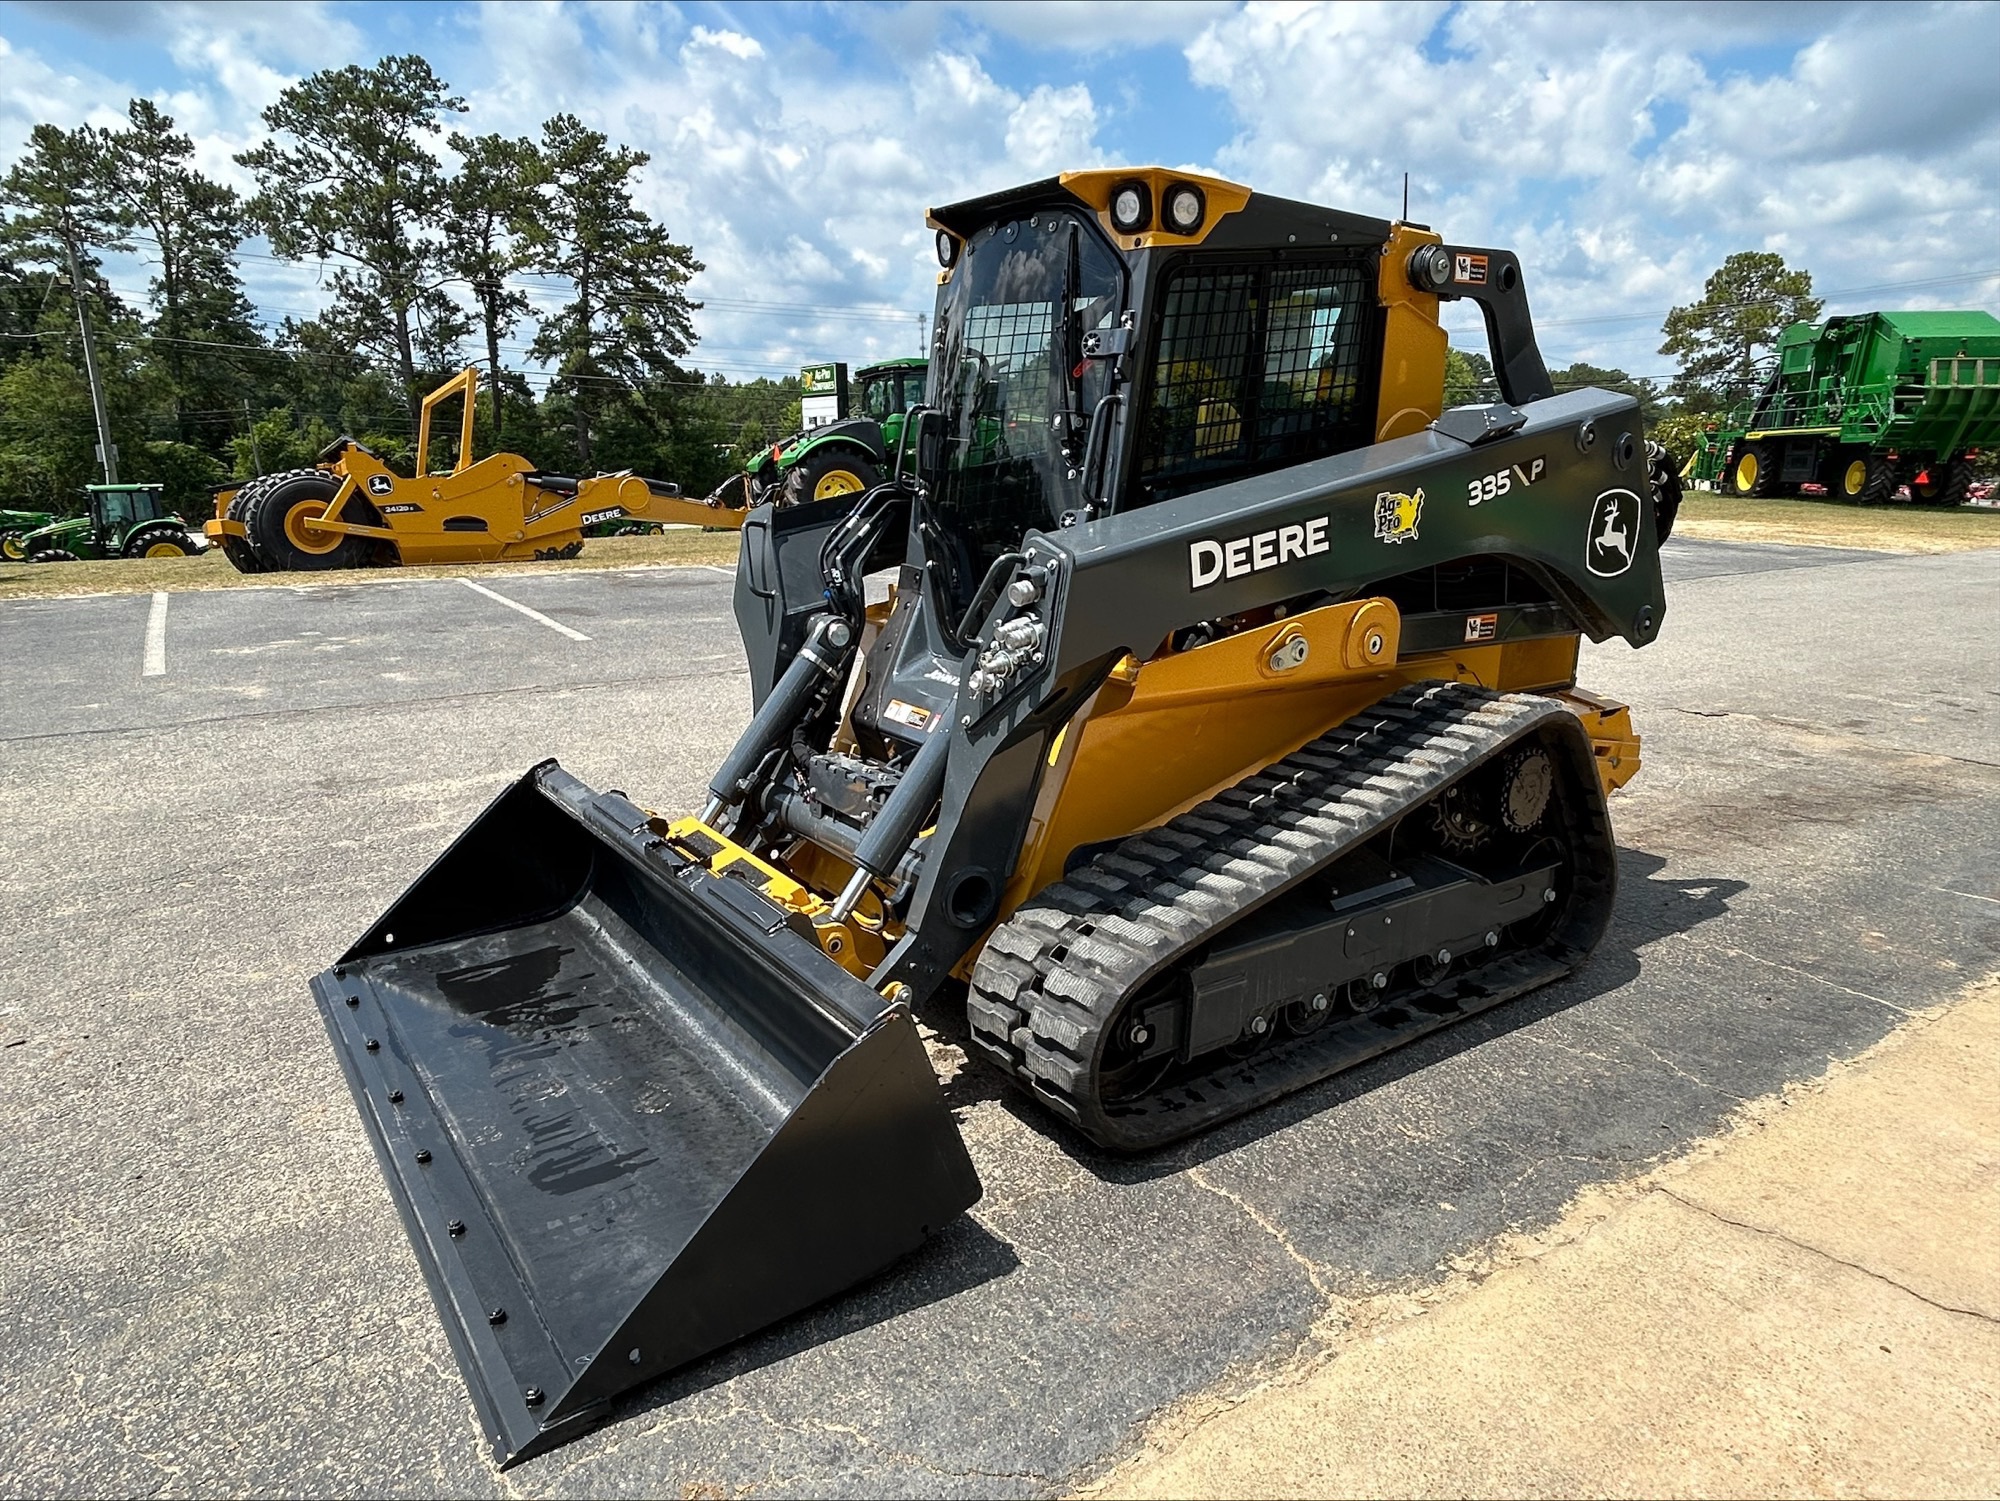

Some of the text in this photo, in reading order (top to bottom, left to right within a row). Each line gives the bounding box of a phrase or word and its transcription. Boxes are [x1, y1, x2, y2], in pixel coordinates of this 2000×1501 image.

[1468, 469, 1511, 507] 335
[582, 508, 622, 525] DEERE
[1378, 515, 1401, 533] Pro
[1190, 516, 1330, 588] DEERE
